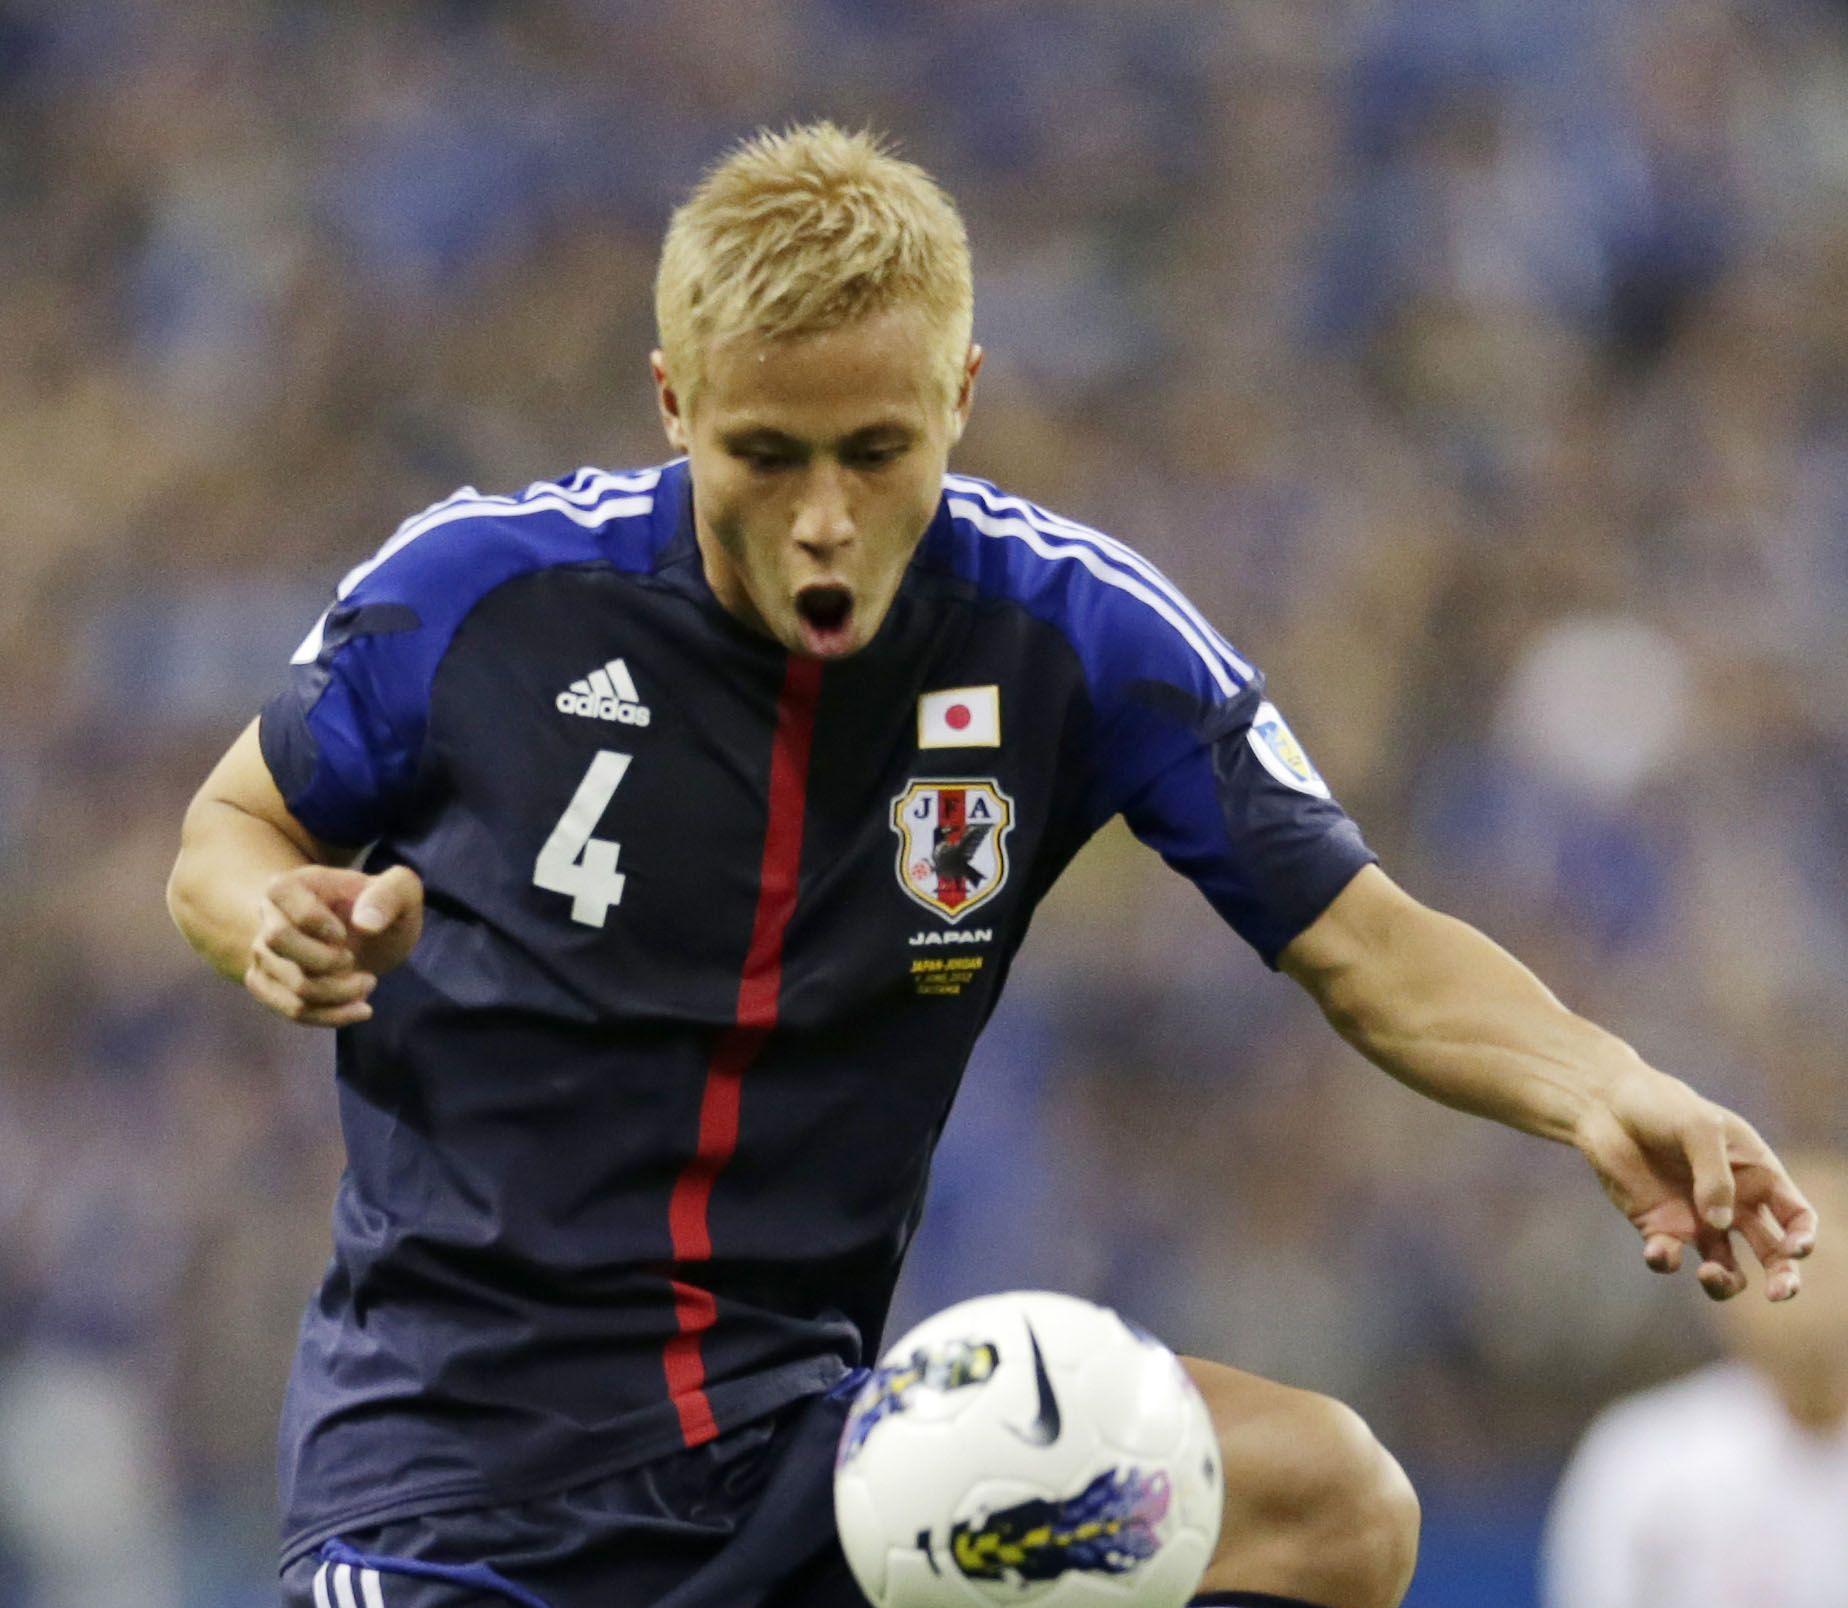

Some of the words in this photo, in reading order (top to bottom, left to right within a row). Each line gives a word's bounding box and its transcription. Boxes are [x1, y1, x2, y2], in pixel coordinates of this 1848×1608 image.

[556, 691, 650, 727] adidas
[533, 750, 633, 928] 4
[909, 928, 993, 945] JAPAN
